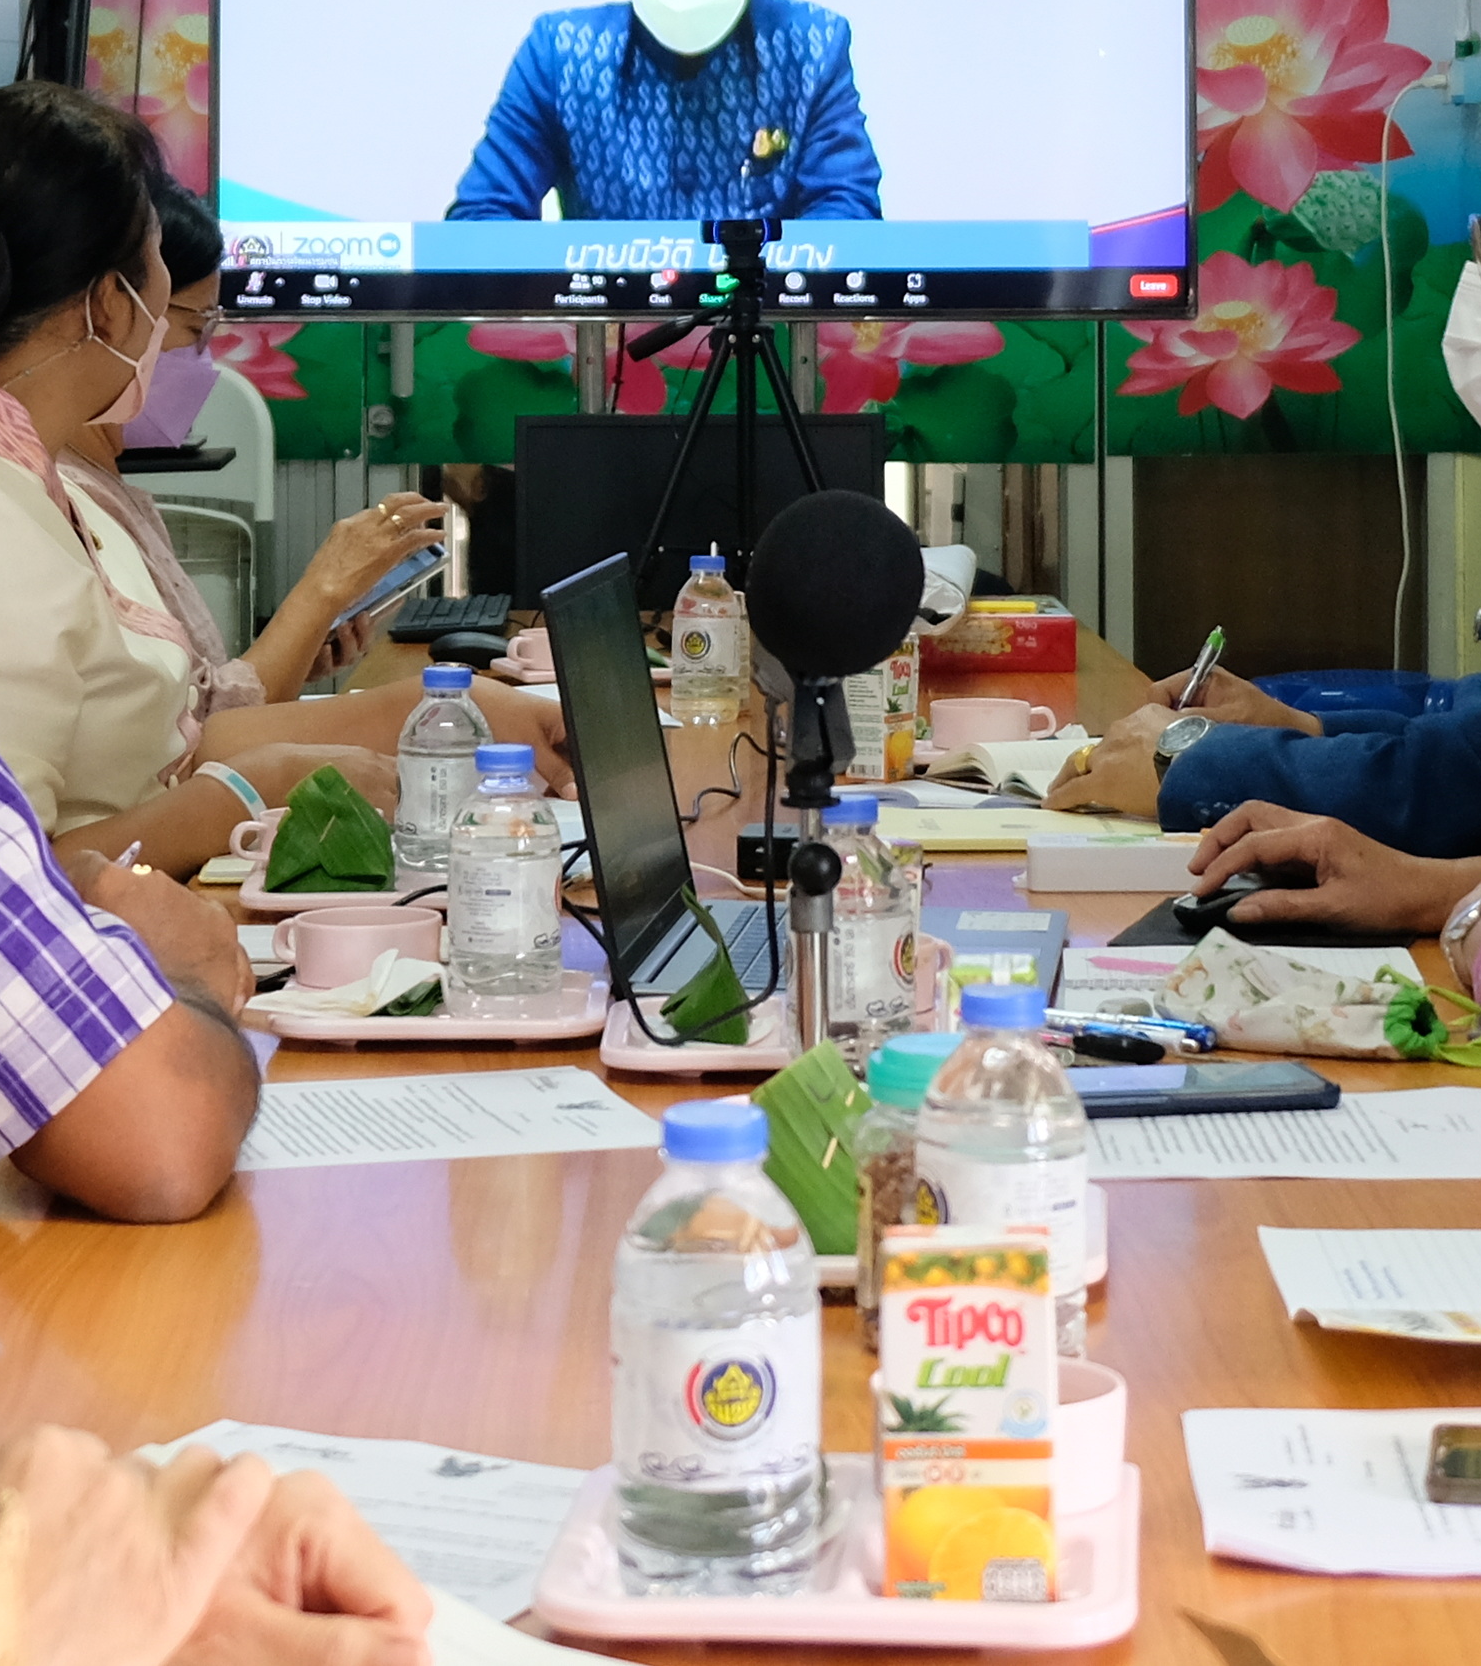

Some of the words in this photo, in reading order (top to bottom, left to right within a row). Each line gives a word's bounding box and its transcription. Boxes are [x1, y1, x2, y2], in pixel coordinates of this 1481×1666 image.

[292, 236, 373, 256] zoom
[565, 237, 695, 271] นายนิวัติ
[236, 295, 274, 305] Unmute
[300, 295, 321, 307] Stop
[322, 295, 350, 305] Video
[554, 294, 606, 307] Participants
[649, 294, 671, 304] Chat
[778, 293, 810, 304] Record
[834, 294, 876, 305] Reactions
[903, 294, 926, 307] Apps
[906, 1296, 1025, 1350] Tipco
[916, 1352, 1013, 1389] Cool
